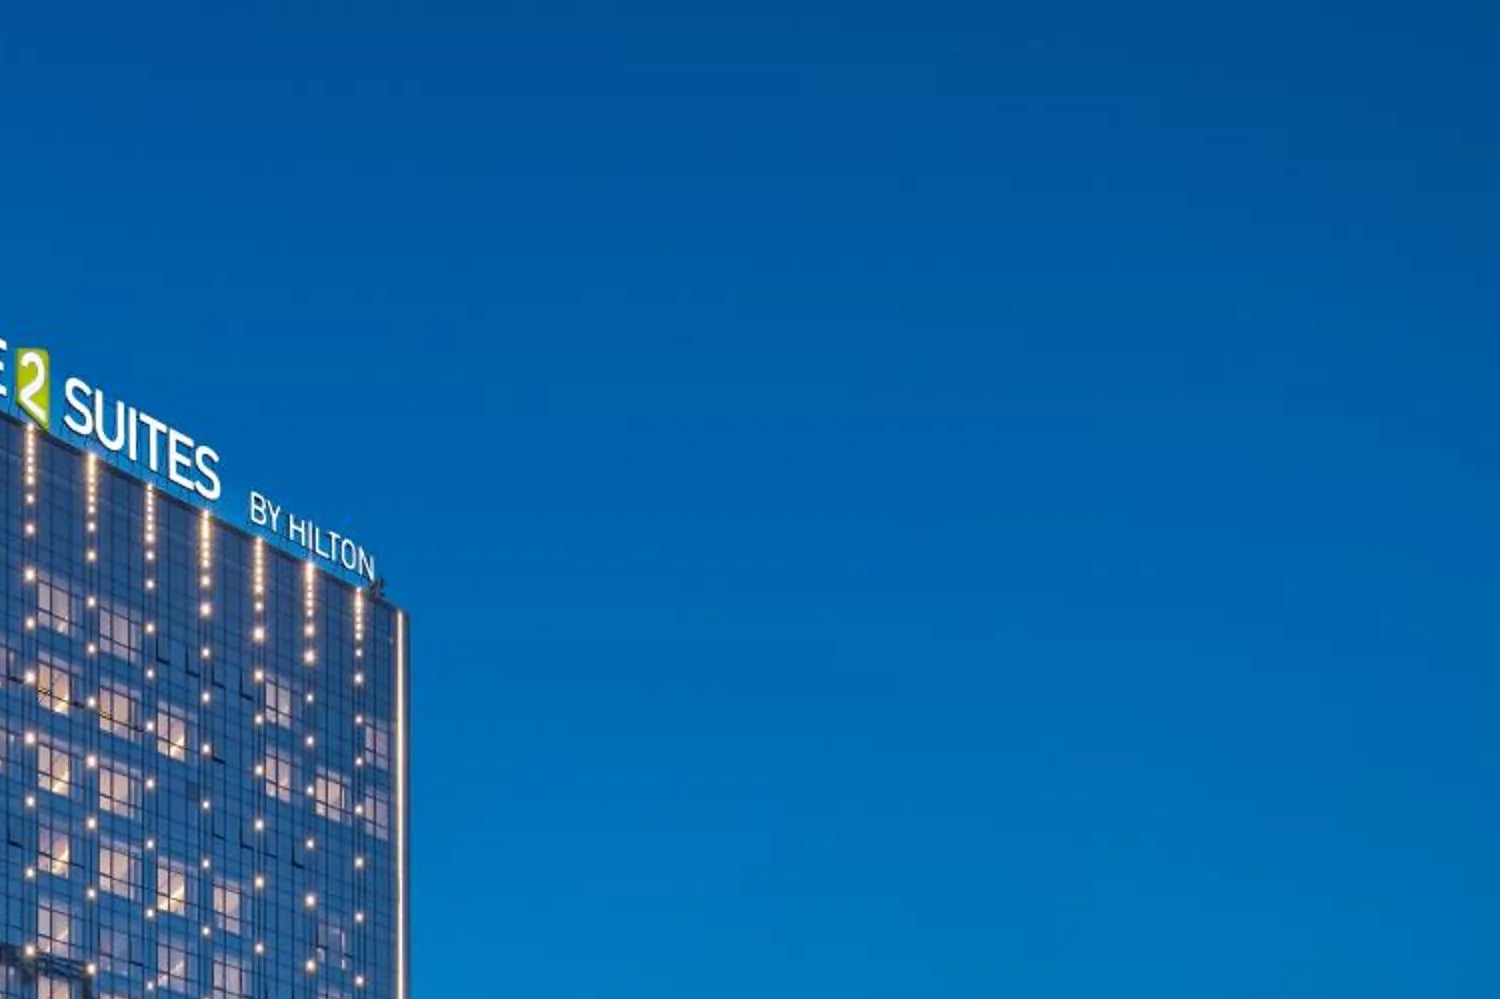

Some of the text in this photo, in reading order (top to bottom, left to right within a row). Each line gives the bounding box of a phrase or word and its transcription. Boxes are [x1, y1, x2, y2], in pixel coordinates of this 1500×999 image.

[19, 351, 47, 425] 2
[64, 377, 221, 500] SUITES
[250, 490, 375, 581] BY HILTON
